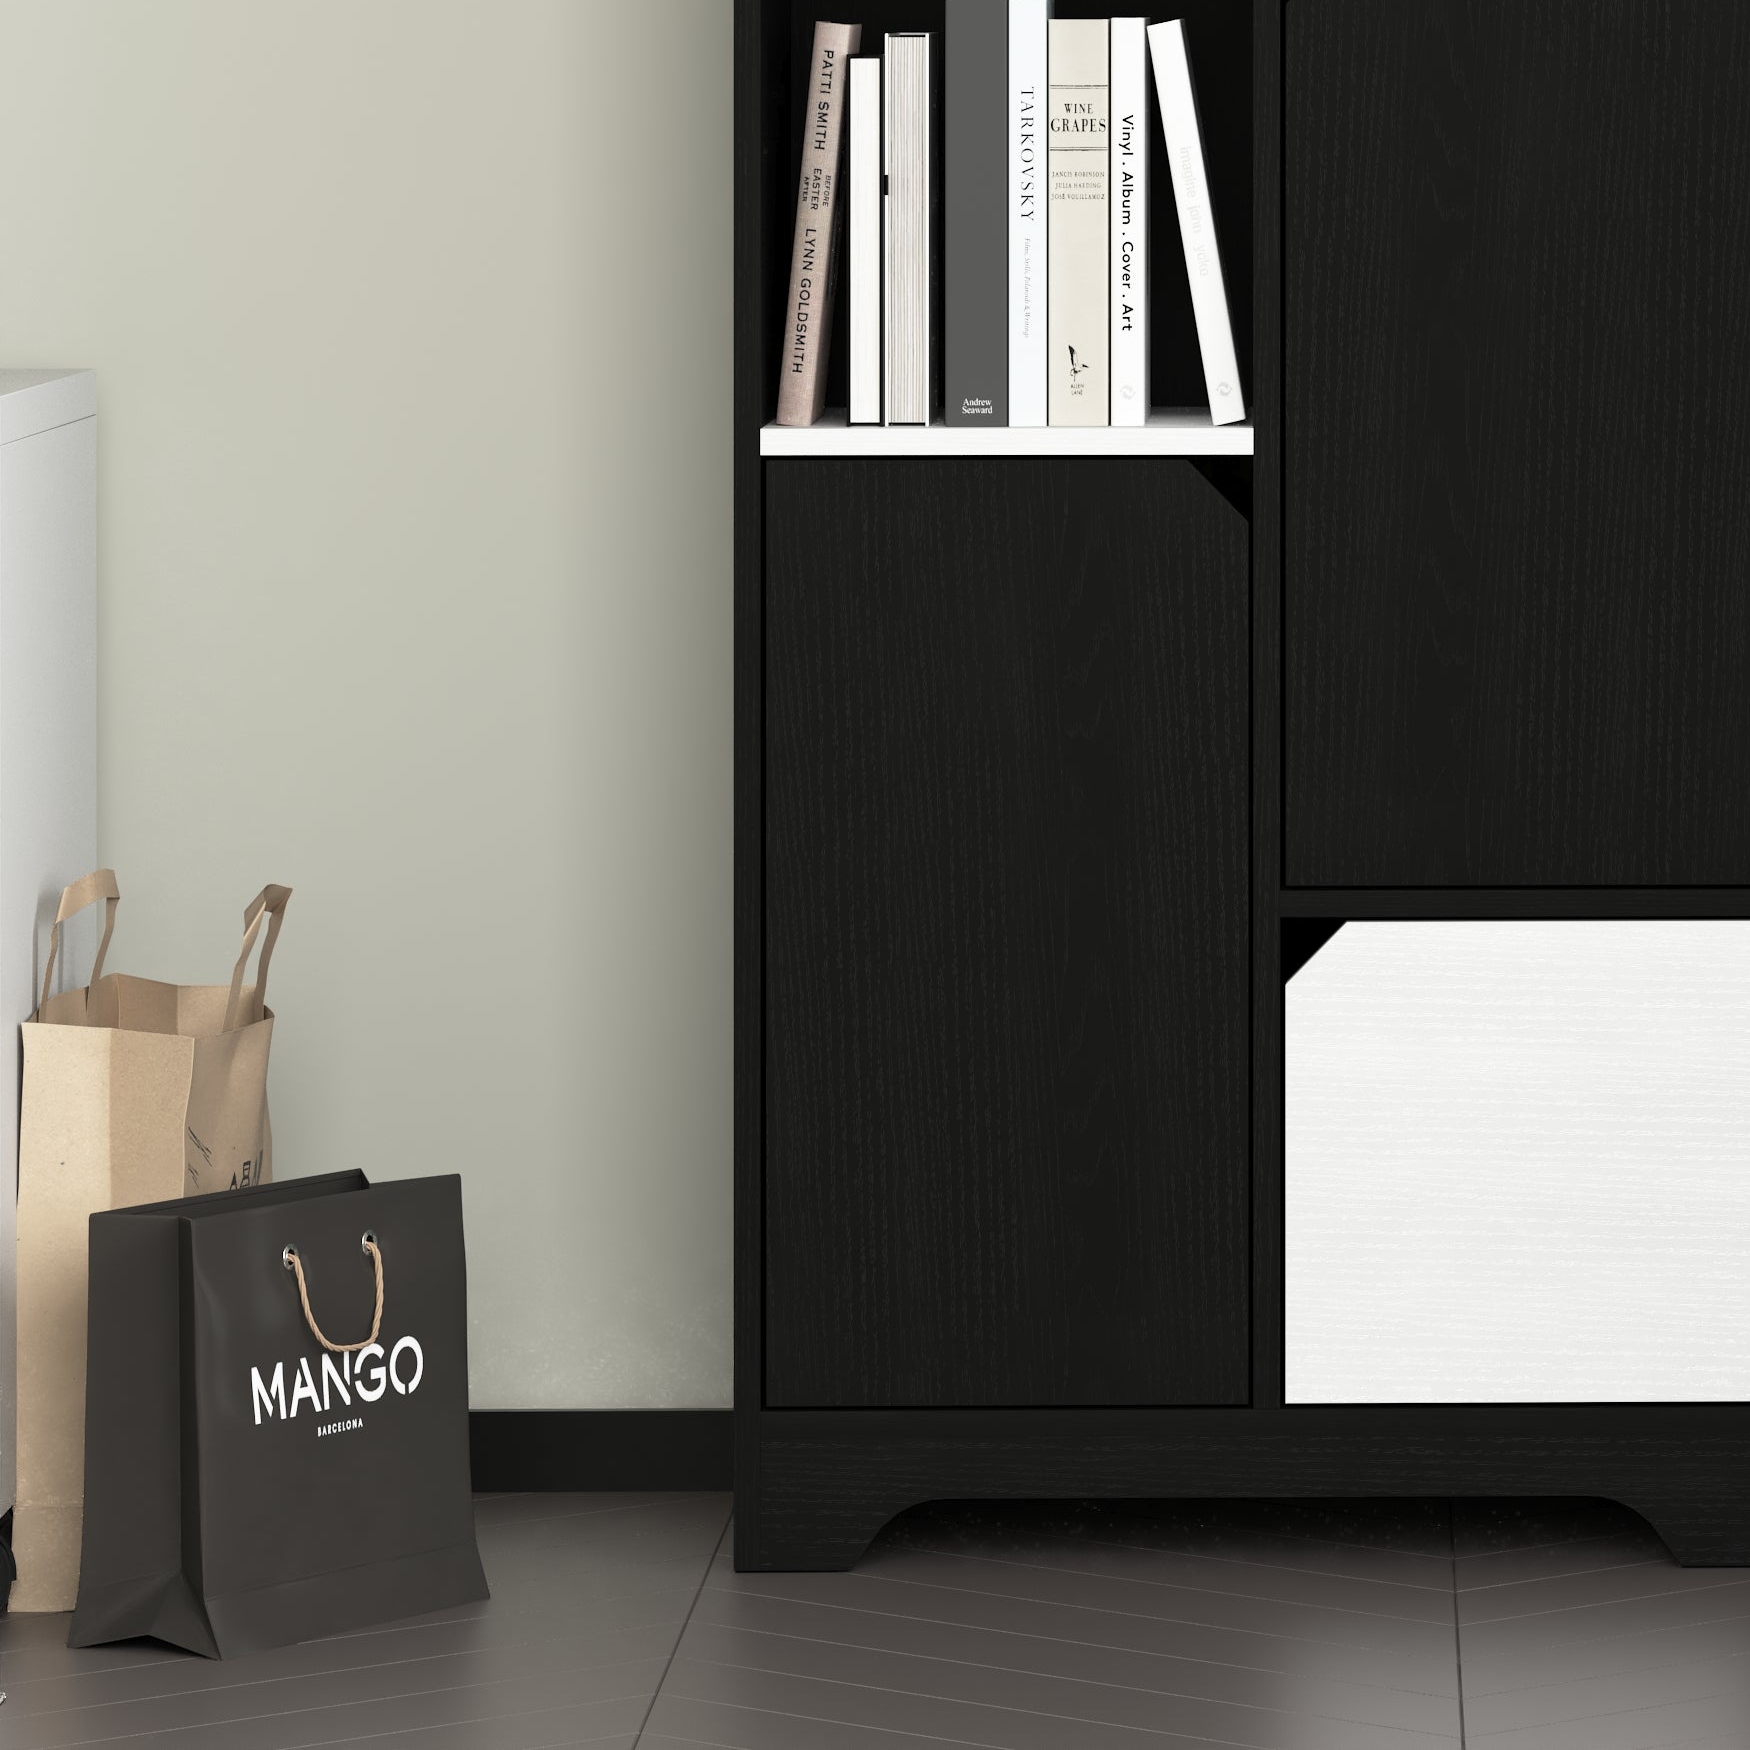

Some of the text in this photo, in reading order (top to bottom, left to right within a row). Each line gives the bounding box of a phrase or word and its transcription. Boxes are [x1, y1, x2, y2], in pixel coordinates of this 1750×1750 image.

[814, 50, 834, 151] PATTI SMITH
[1064, 103, 1093, 114] WINE
[1050, 118, 1106, 132] GRAPES
[1020, 86, 1035, 221] TARKOVSKY
[810, 167, 822, 210] EASTER
[822, 175, 831, 207] BEFORE
[1118, 114, 1134, 332] Vinyl Album Cover Art
[792, 228, 816, 373] LYNN GOLDSMITH
[961, 406, 993, 414] Seaward
[963, 398, 992, 406] Andrew
[250, 1335, 424, 1425] MANGO
[317, 1417, 364, 1438] BARCELONA
